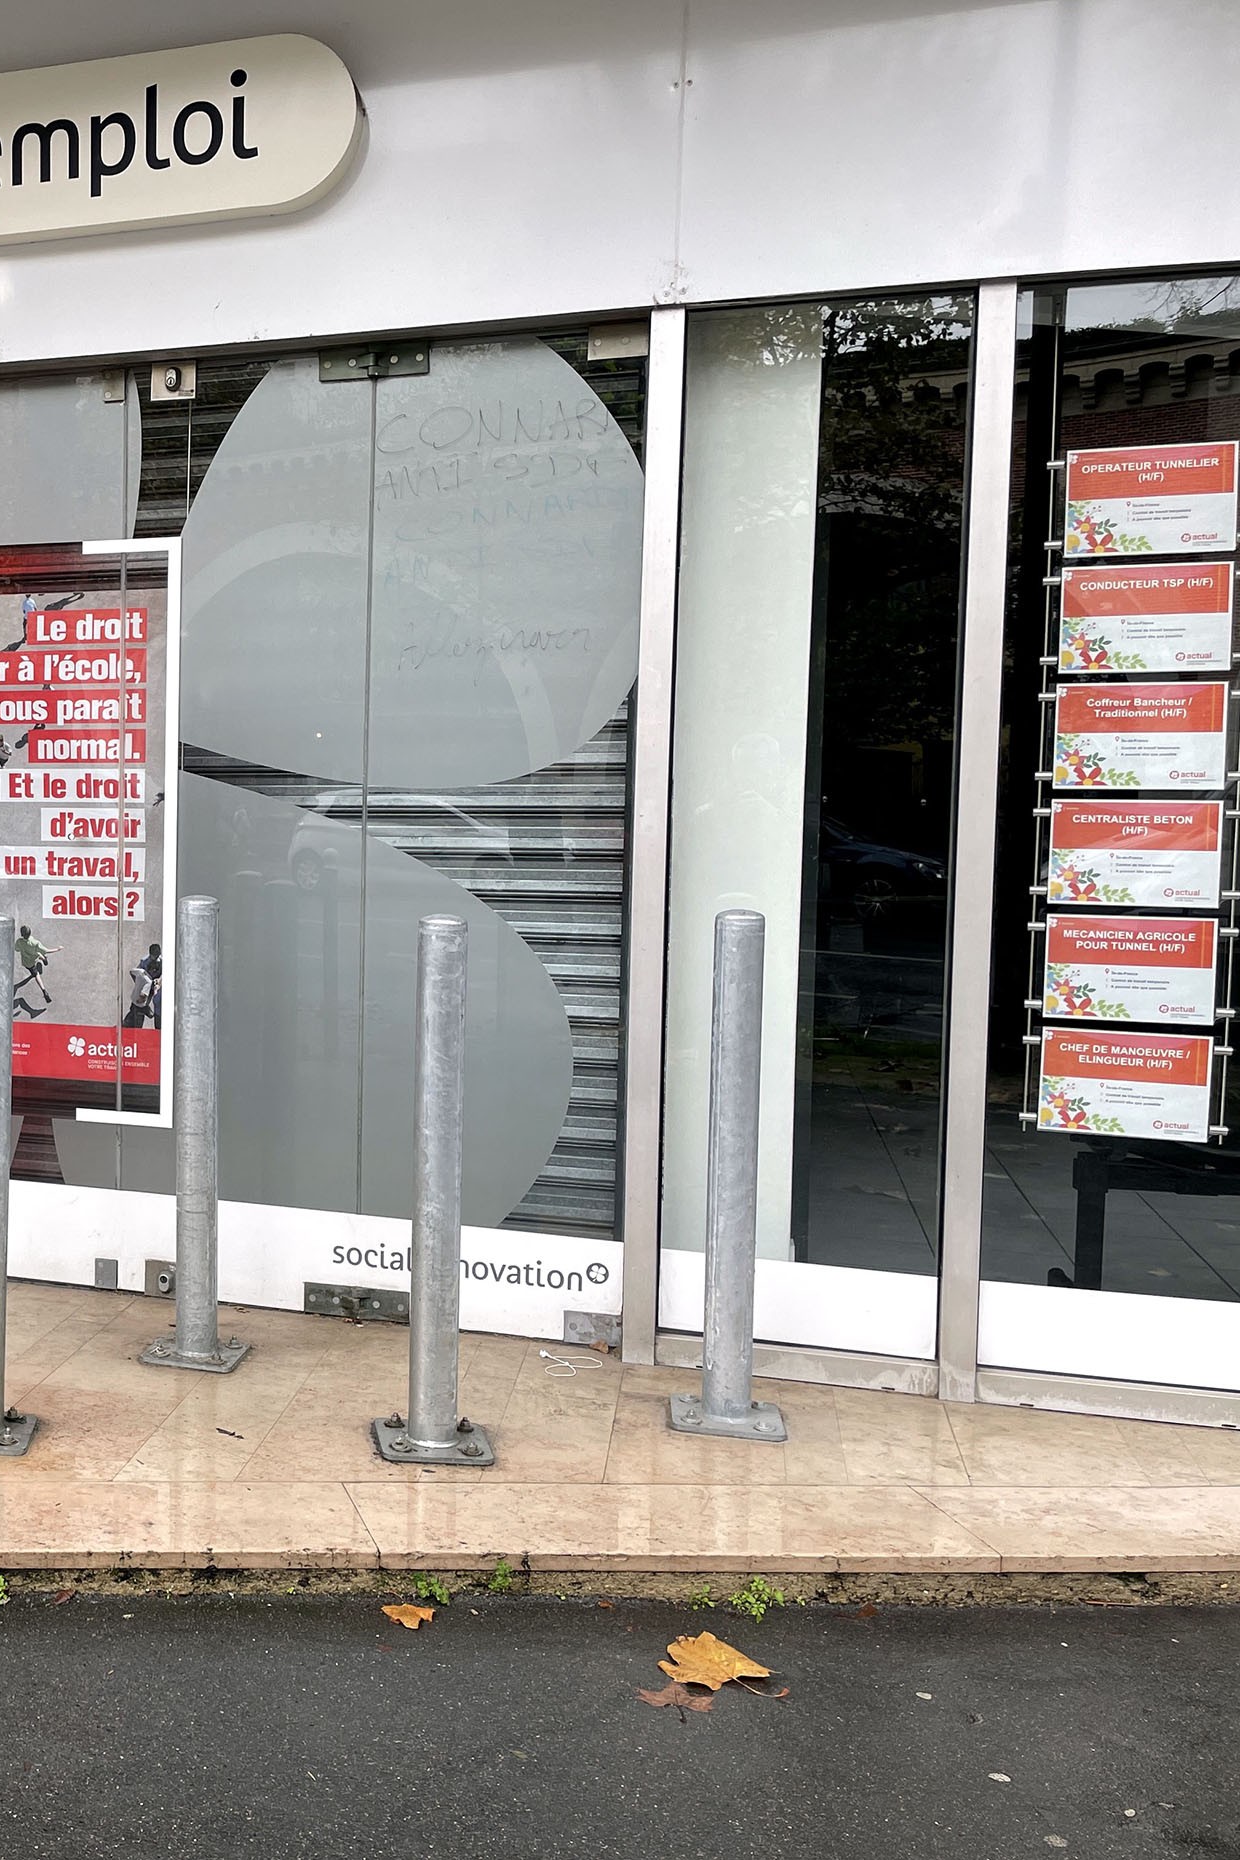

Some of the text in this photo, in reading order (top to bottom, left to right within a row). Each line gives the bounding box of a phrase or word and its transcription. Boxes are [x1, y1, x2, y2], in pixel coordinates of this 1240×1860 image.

[1082, 458, 1219, 473] OPERATEUR TUNNELIER
[1139, 472, 1164, 483] (H/F)
[1192, 532, 1218, 541] actual
[1080, 578, 1213, 590] CONDUCTEUR TSP (H/F)
[37, 613, 143, 641] Le droit
[1187, 651, 1212, 660] actual
[18, 656, 34, 681] à
[44, 654, 141, 684] l'école,
[1086, 697, 1131, 707] Coffreur
[1134, 697, 1187, 707] Bancheur
[1094, 708, 1186, 718] Traditionnel (H/F)
[38, 731, 140, 762] normal.
[1180, 770, 1206, 779] actual
[9, 773, 141, 799] Et le droit
[50, 812, 140, 838] d'avoir
[1073, 815, 1193, 824] CENTRALISTE BETON
[1122, 826, 1148, 837] (H/F)
[5, 856, 36, 875] un
[1175, 888, 1201, 897] actual
[51, 890, 139, 917] alors ?
[1064, 930, 1195, 941] MECANICIEN AGRICOLE
[1076, 941, 1185, 954] POUR TUNNEL (H/F)
[1170, 1005, 1196, 1013] actual
[88, 1042, 138, 1059] actual
[1060, 1043, 1090, 1052] CHEF
[1093, 1045, 1108, 1053] DE
[1111, 1046, 1184, 1059] MANOEUVRE
[1079, 1054, 1172, 1070] ELINGUEUR (H/F)
[1164, 1121, 1190, 1129] actual
[333, 1241, 413, 1273] social
